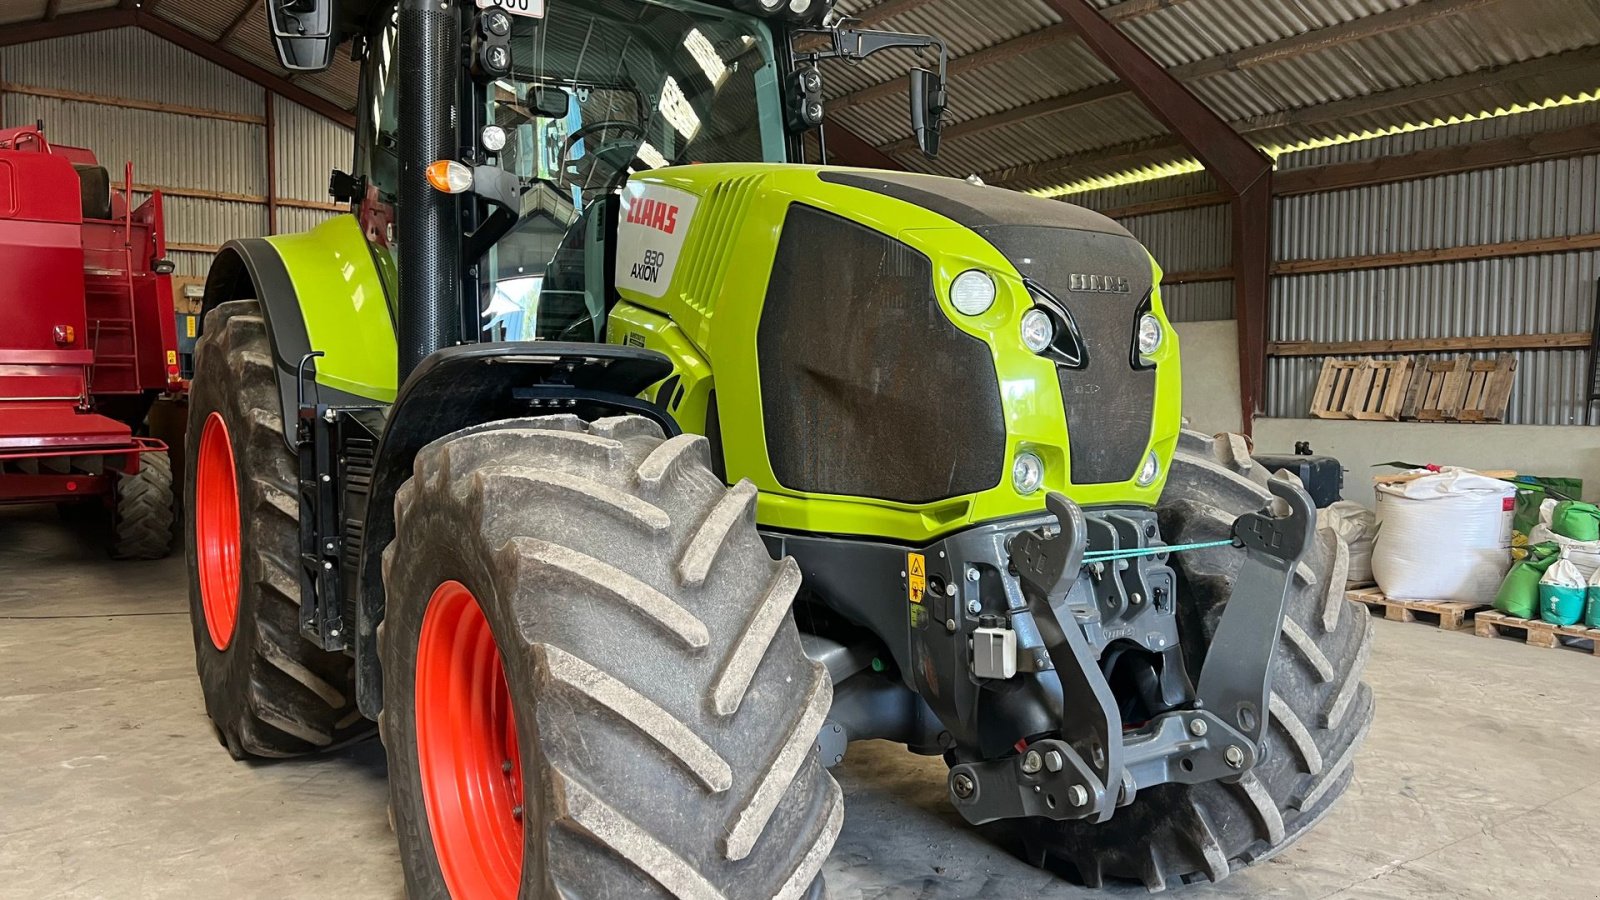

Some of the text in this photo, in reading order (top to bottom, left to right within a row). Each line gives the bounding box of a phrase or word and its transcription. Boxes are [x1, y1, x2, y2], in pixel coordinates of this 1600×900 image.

[627, 197, 679, 234] CLAAS
[644, 249, 664, 268] 830
[630, 262, 659, 283] AXION
